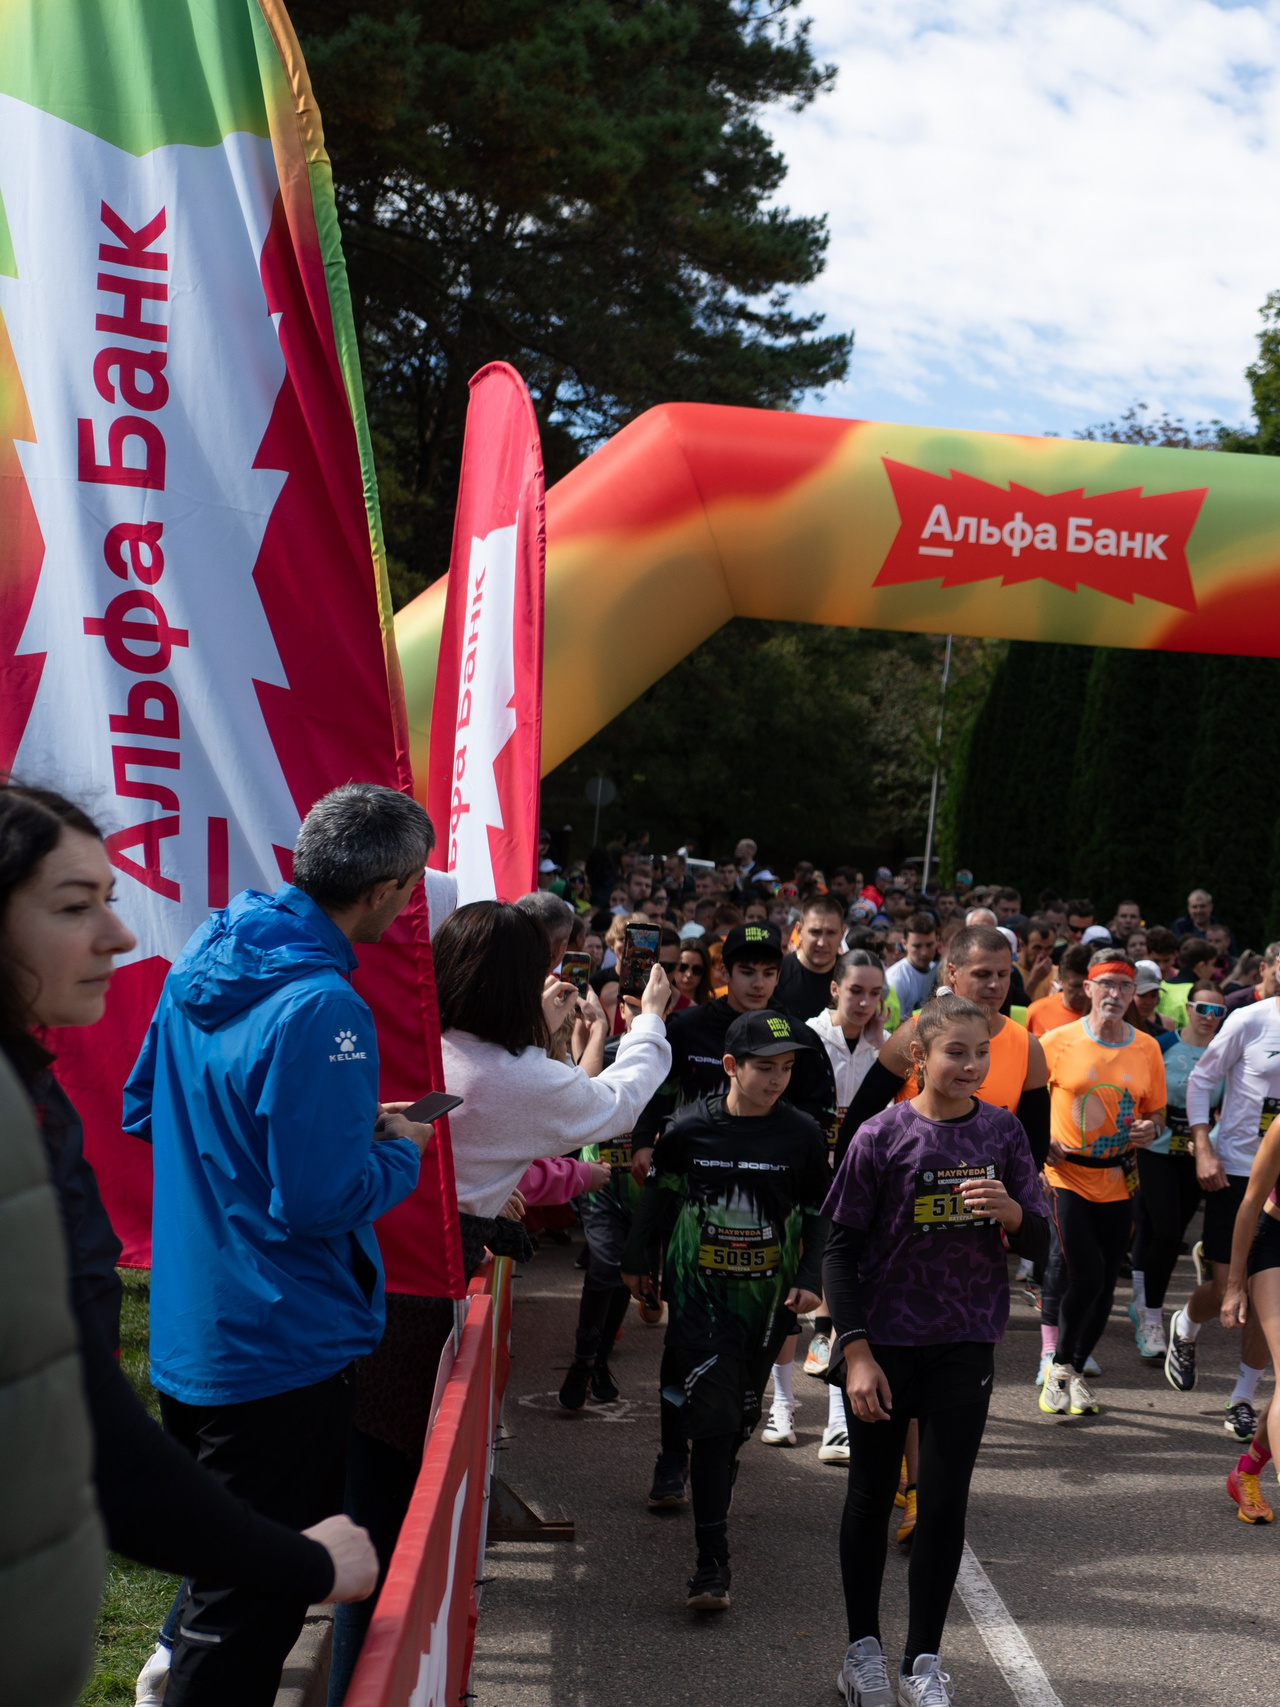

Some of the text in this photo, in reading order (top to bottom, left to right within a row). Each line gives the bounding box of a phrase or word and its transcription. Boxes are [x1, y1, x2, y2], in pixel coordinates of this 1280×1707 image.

[920, 504, 1170, 560] Альфа Банк
[77, 198, 190, 903] Альфа Банк
[457, 565, 487, 733] Банк
[329, 1052, 367, 1062] KELME
[693, 1158, 789, 1171] ГОРЫ ЗОВУТ
[938, 1168, 985, 1177] MAYRVEDA
[932, 1196, 986, 1217] 51
[718, 1228, 761, 1236] MAYRVEDA
[713, 1249, 766, 1267] 5095
